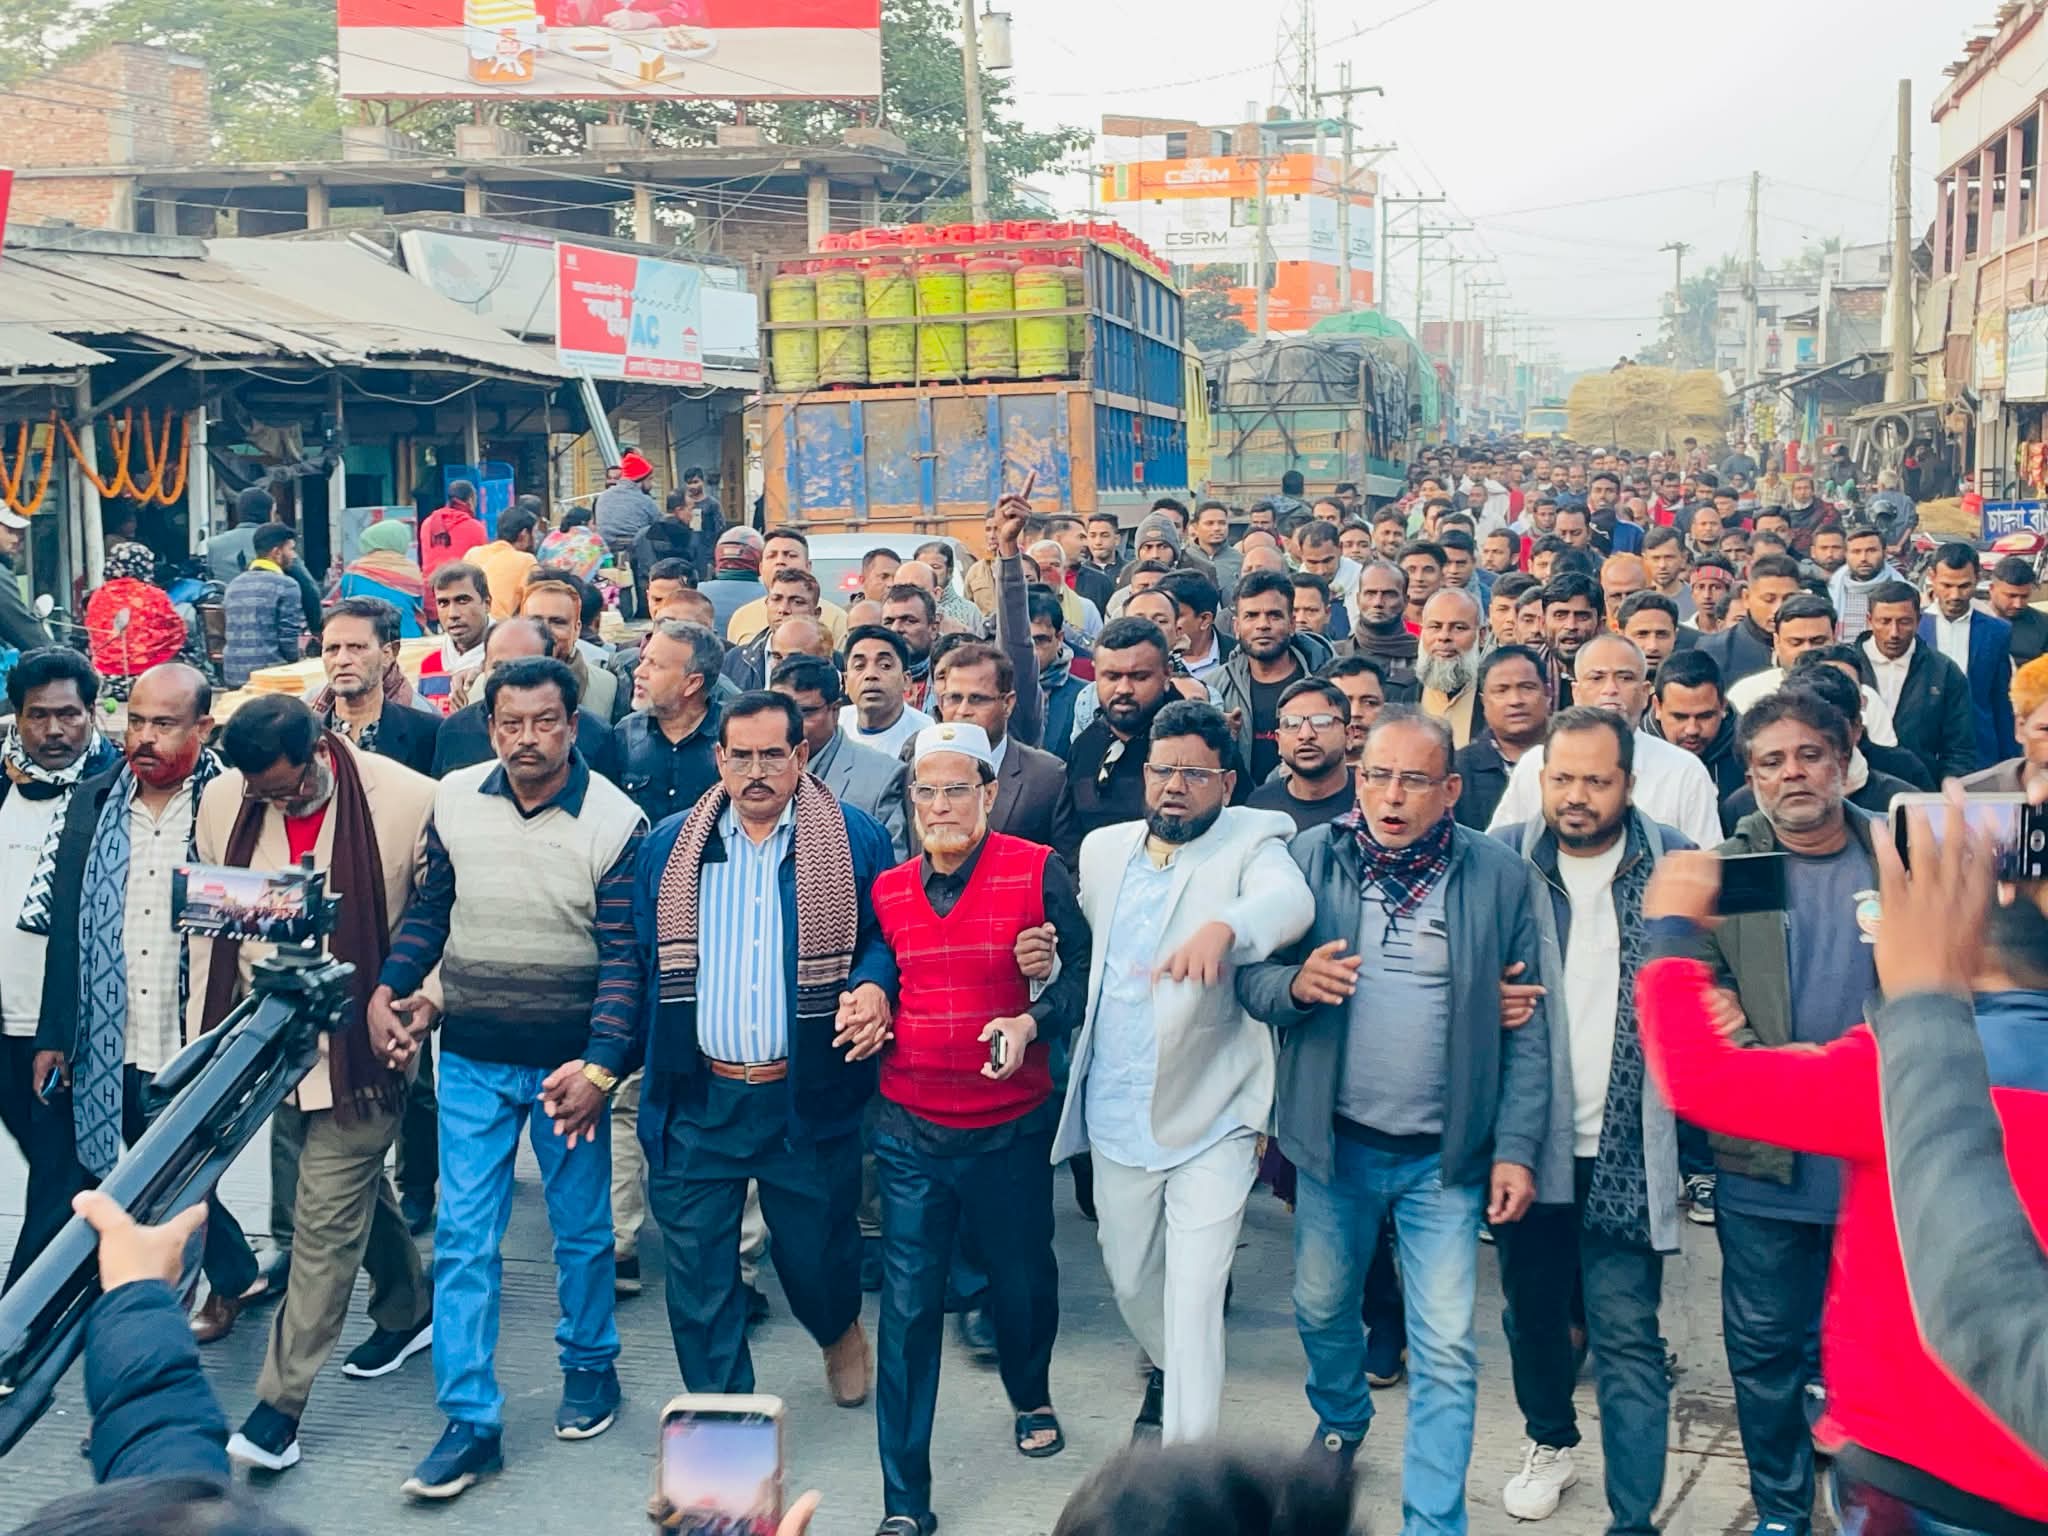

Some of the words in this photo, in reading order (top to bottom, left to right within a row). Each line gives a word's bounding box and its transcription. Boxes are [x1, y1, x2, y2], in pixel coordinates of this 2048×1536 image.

[1165, 168, 1229, 185] CSRM
[1165, 231, 1228, 246] CSRM
[632, 313, 659, 346] AC
[106, 836, 121, 860] H
[106, 981, 119, 1005] H
[104, 1034, 116, 1057] H
[104, 1084, 115, 1107] H
[104, 1131, 114, 1153] H
